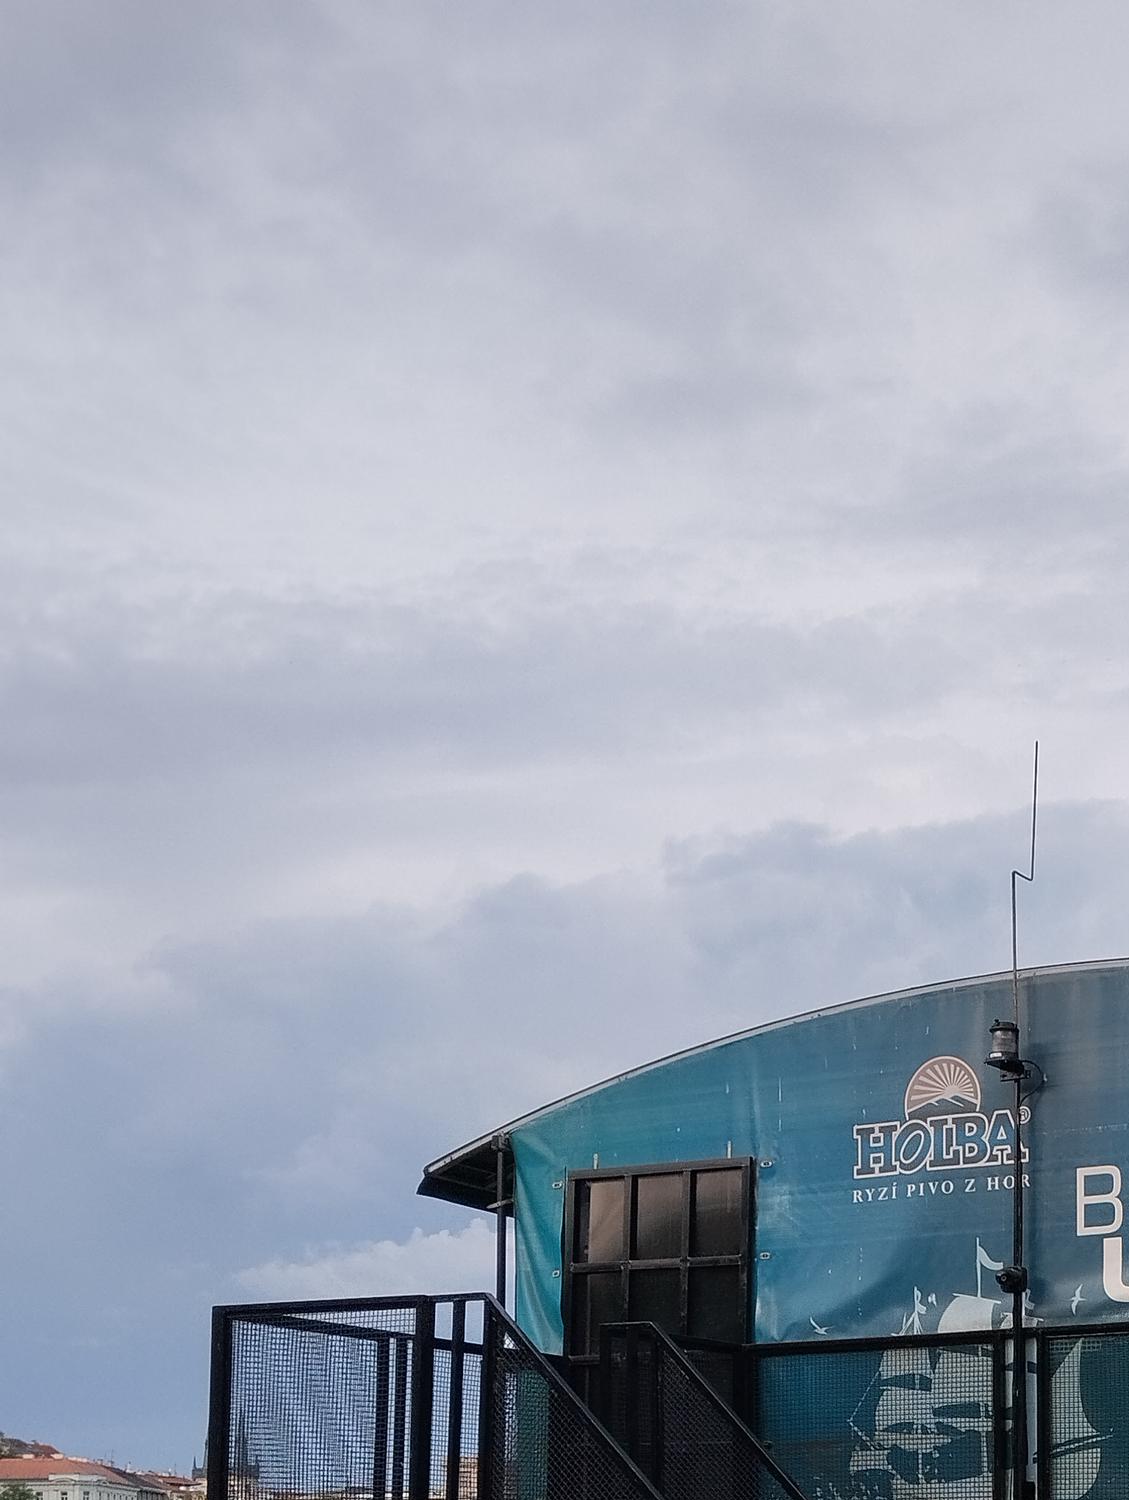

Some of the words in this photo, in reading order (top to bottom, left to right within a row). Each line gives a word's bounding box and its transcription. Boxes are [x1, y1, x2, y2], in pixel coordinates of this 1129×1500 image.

[853, 1109, 1028, 1180] HOLBA
[852, 1182, 898, 1204] RYZÍ
[905, 1179, 955, 1198] PIVO
[964, 1178, 977, 1194] Z
[987, 1174, 1031, 1191] HOR
